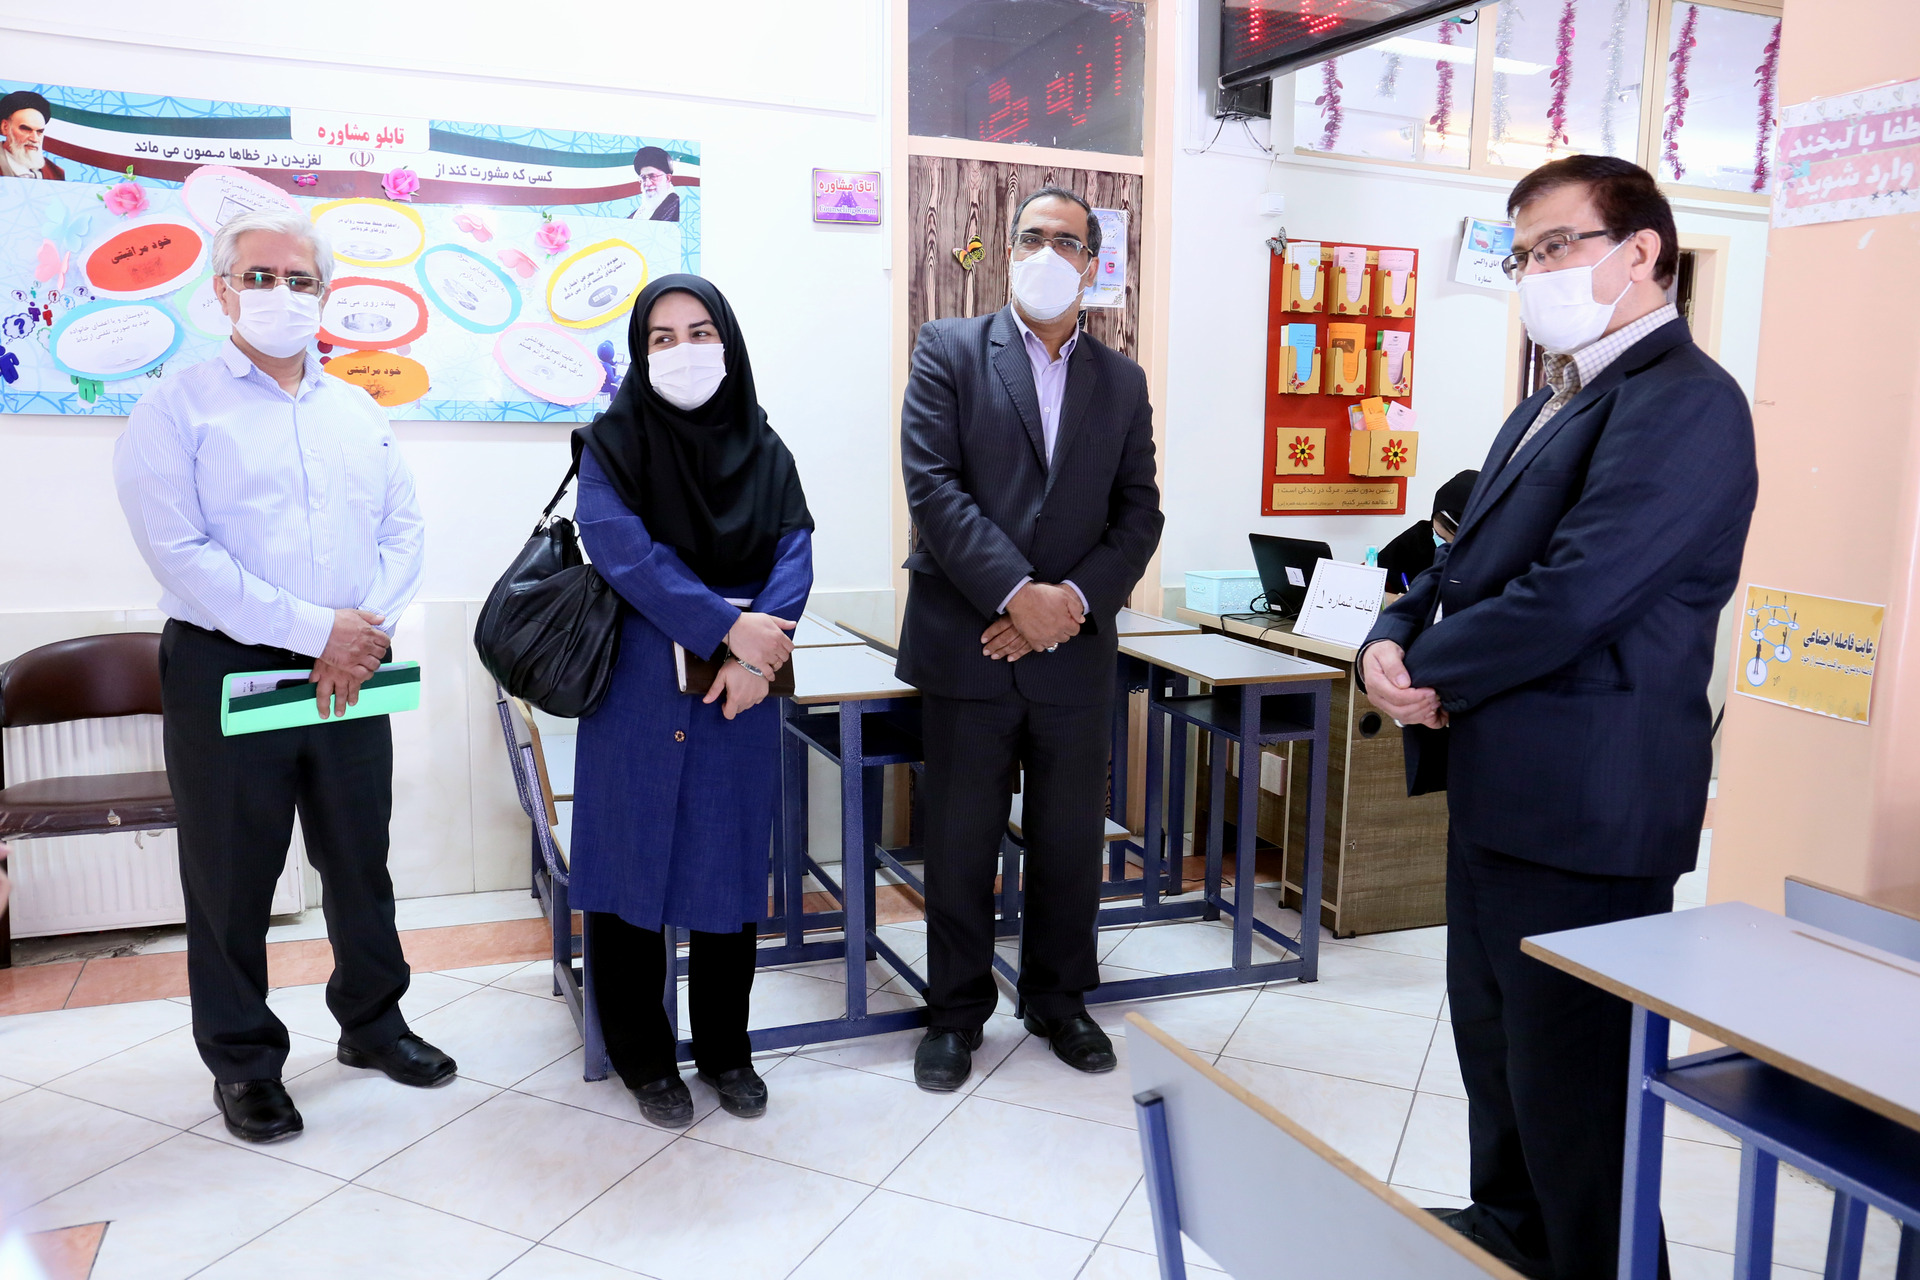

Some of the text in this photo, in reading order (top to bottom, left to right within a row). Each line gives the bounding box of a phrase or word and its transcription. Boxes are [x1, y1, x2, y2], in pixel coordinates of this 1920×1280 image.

[318, 123, 404, 148] تابلو مشاوره
[1789, 122, 1852, 158] لبخند
[1881, 115, 1920, 143] طفا
[134, 141, 322, 168] لغزیدن در خطاها مصون می ماند
[435, 163, 553, 185] کسی که مشورت کند از
[819, 179, 875, 193] اتاق مشاوره
[1796, 156, 1914, 199] وارد شوید
[819, 204, 876, 216] Counseling Room
[112, 236, 171, 264] خود مراقبتی
[347, 366, 401, 377] خود مراقبتی
[1328, 594, 1352, 609] شماره
[1803, 628, 1876, 661] رعایت فاصله اجتماعی
